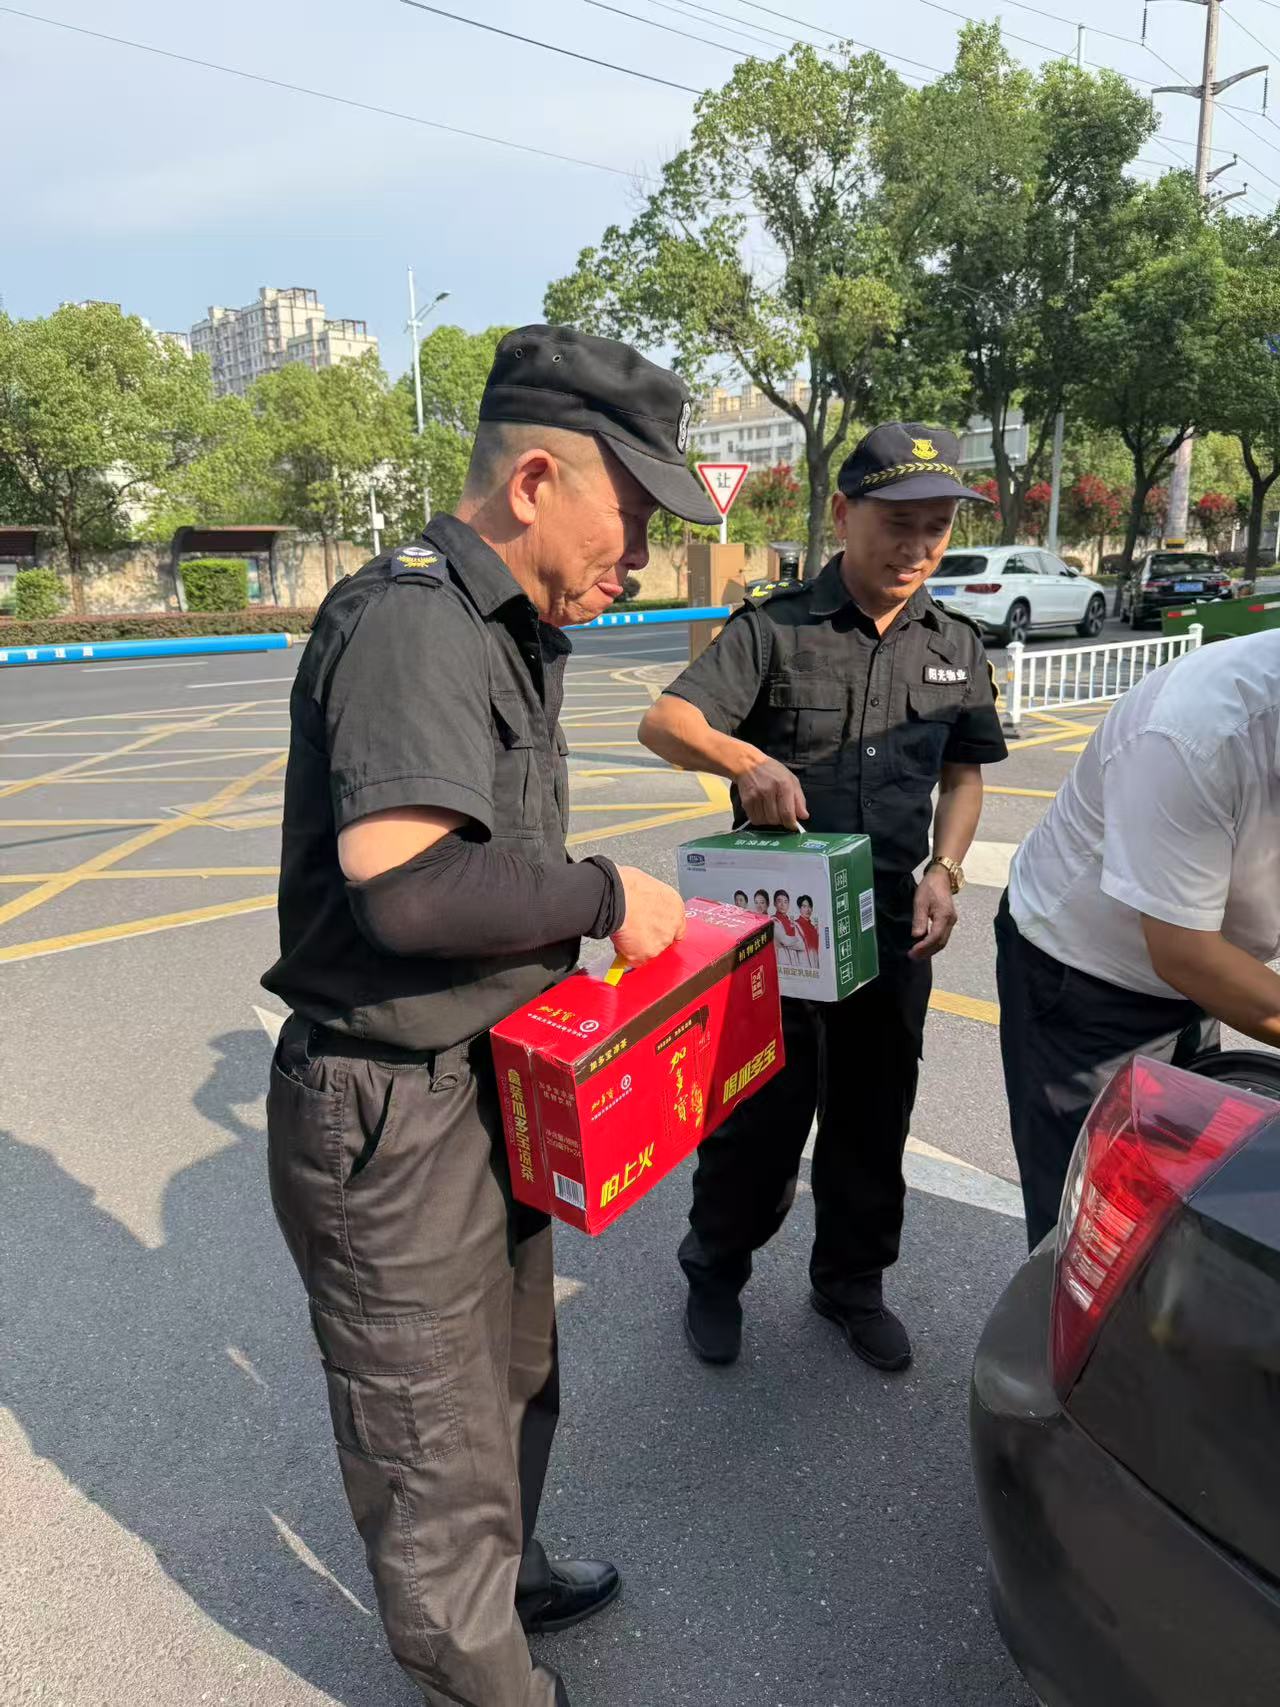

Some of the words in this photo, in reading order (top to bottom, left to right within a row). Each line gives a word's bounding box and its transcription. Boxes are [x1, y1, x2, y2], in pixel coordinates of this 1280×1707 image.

[716, 472, 731, 488] 让
[928, 667, 968, 682] 阳光物业
[723, 1038, 777, 1104] 喝加多宝
[600, 1142, 655, 1208] 怕上火
